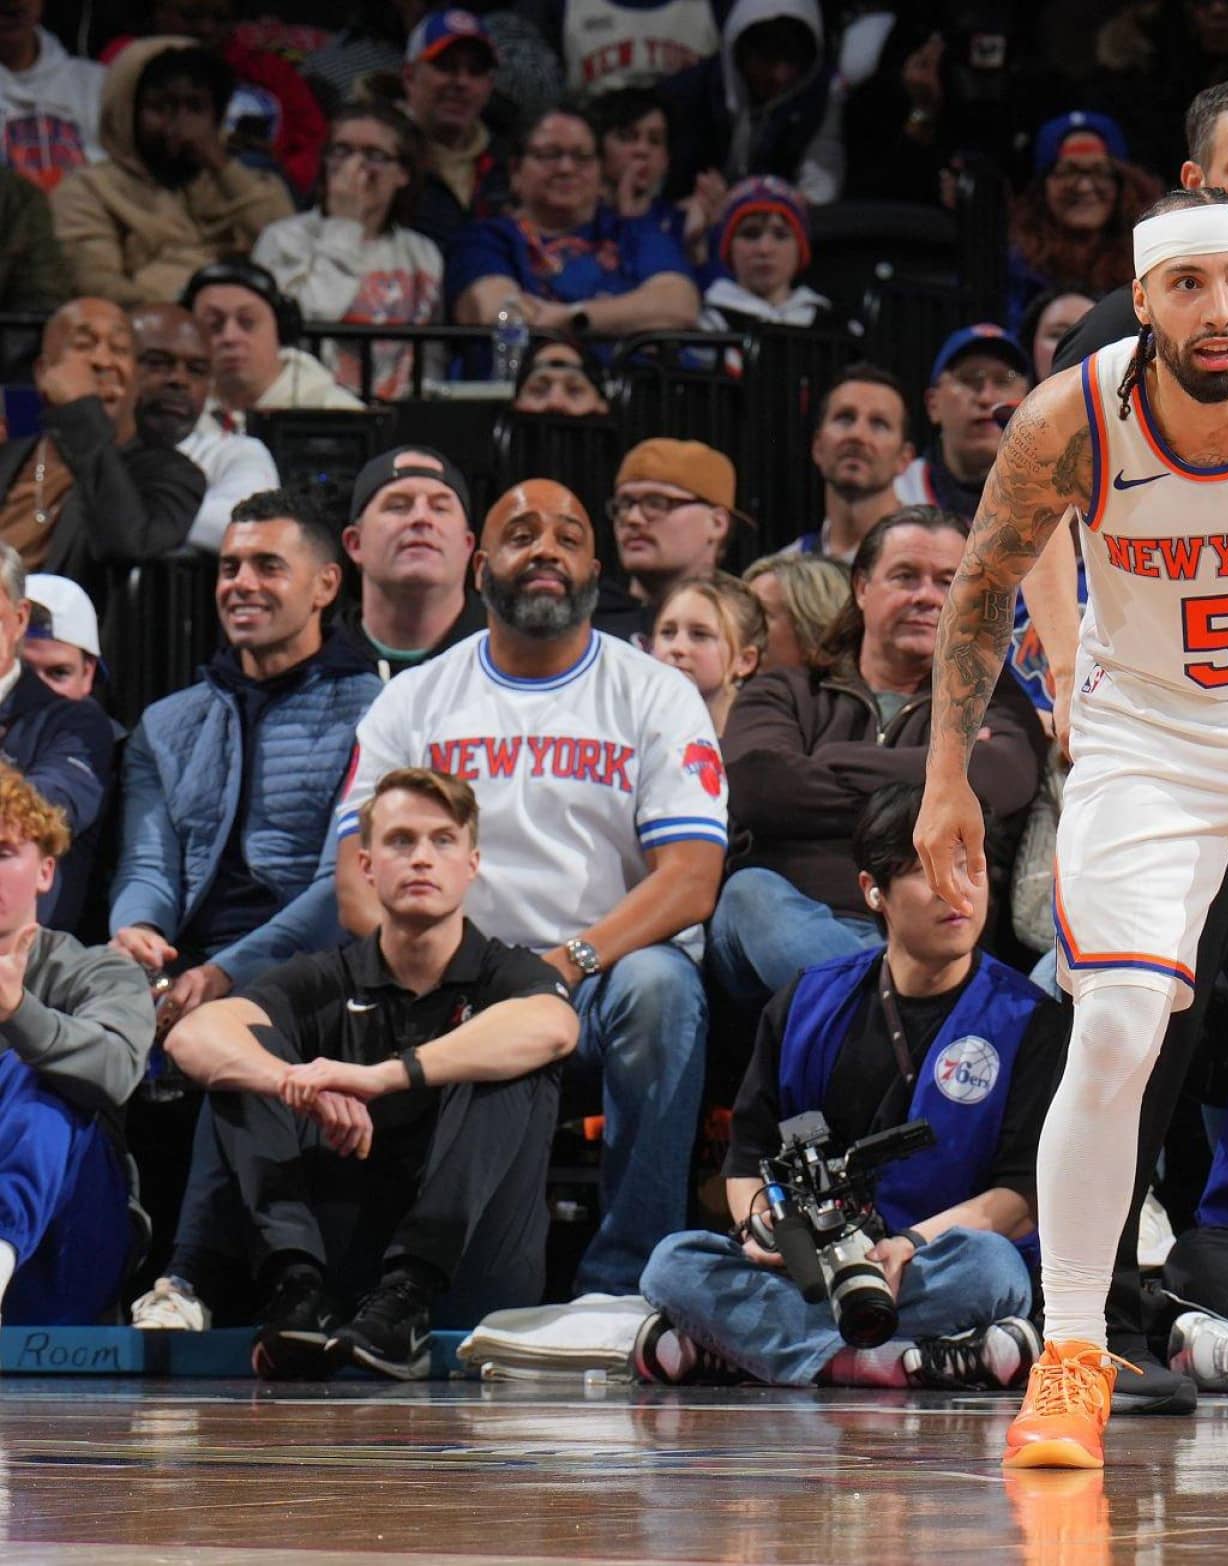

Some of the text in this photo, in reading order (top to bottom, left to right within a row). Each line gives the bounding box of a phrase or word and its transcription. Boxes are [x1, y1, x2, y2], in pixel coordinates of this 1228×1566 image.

[1102, 532, 1204, 580] NEW
[429, 736, 523, 781] NEW
[527, 736, 635, 793] YORK
[17, 1331, 121, 1370] Room
